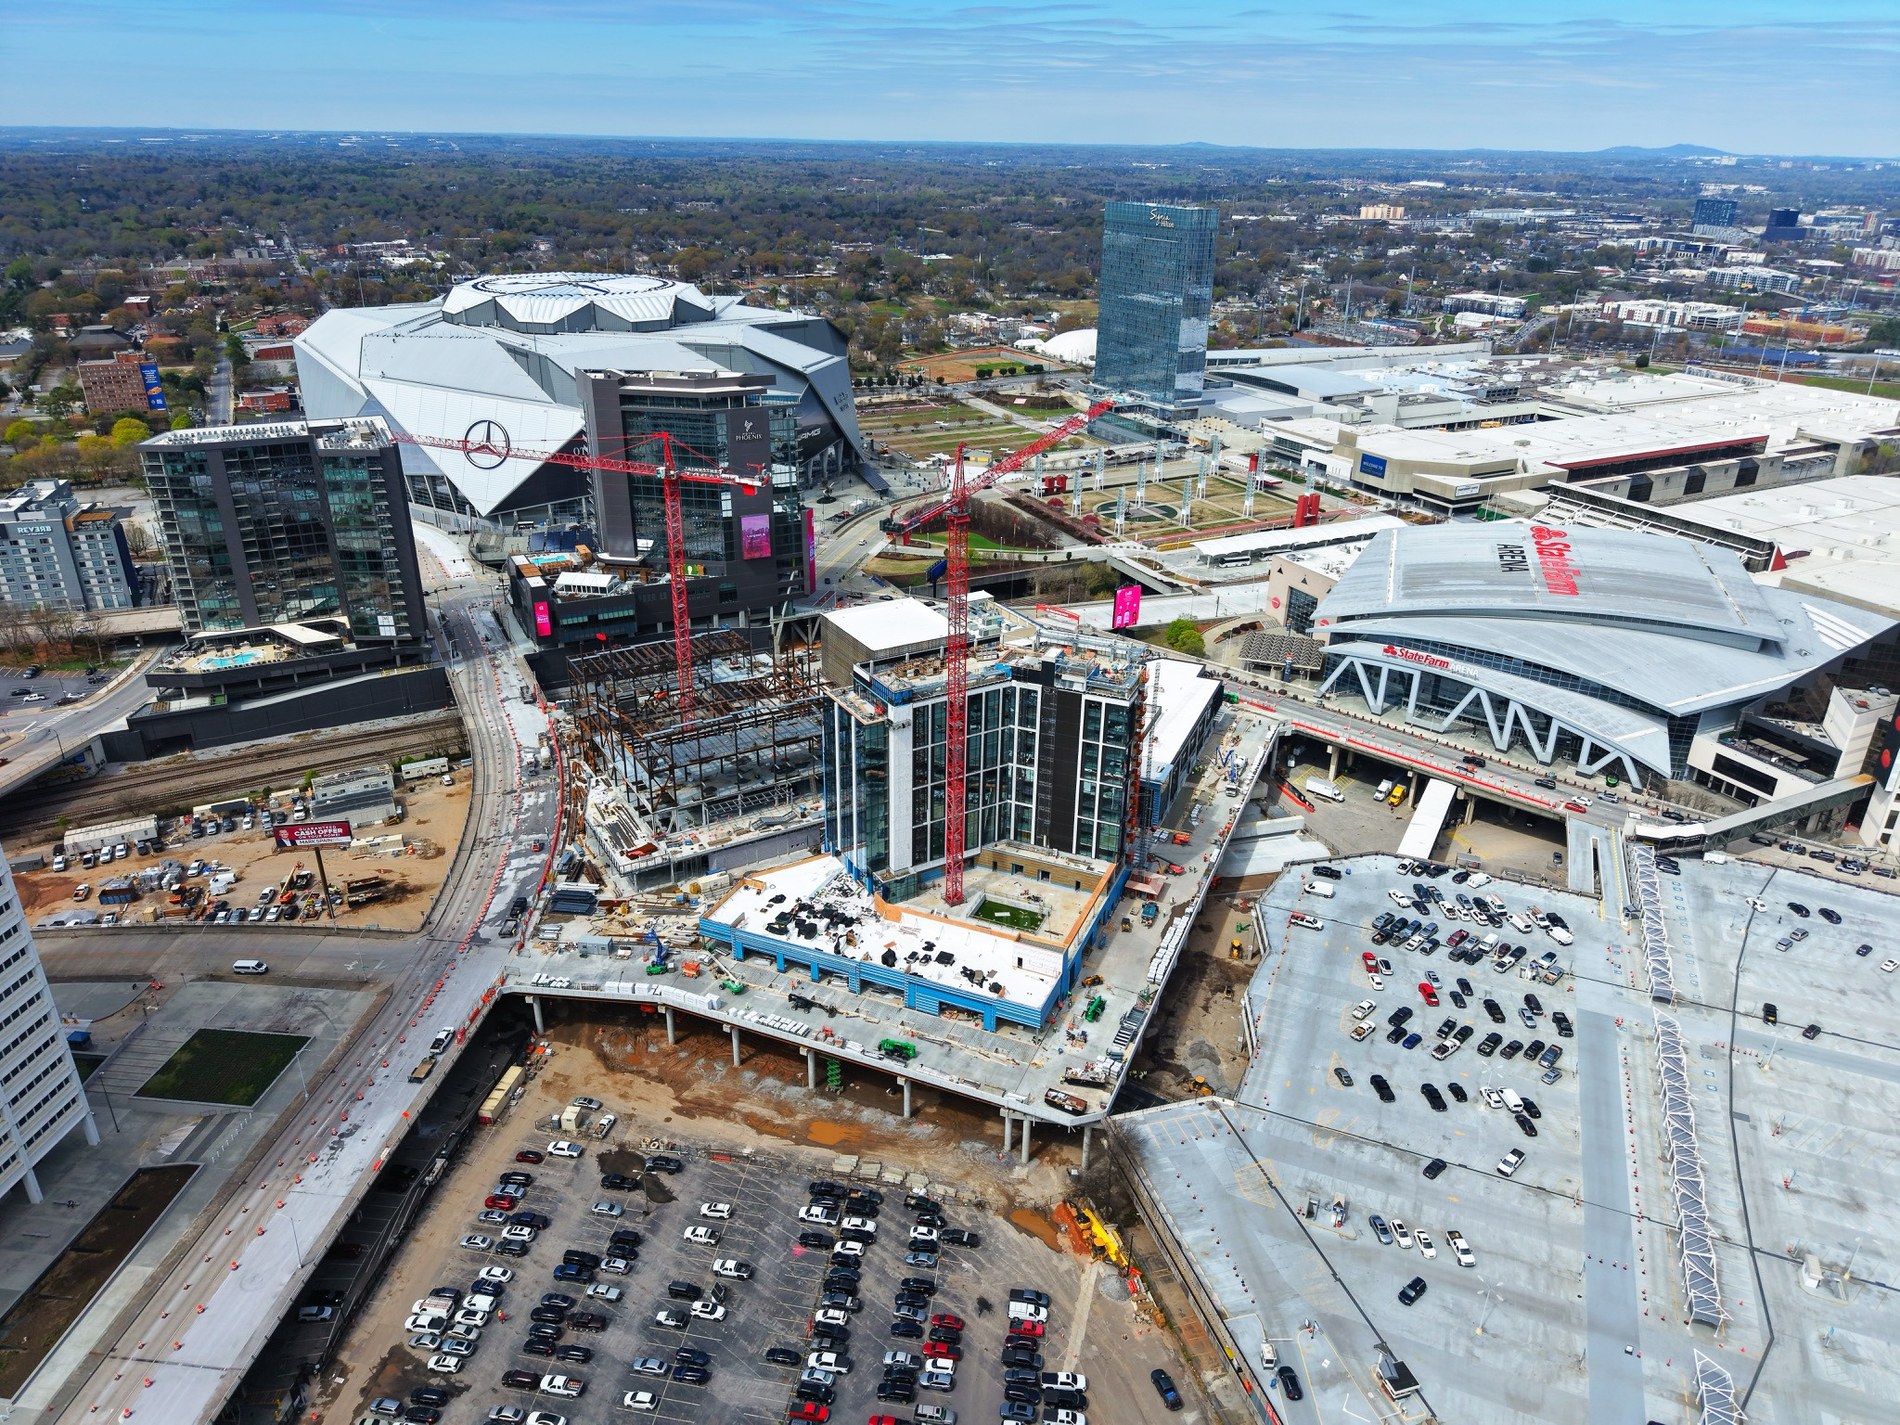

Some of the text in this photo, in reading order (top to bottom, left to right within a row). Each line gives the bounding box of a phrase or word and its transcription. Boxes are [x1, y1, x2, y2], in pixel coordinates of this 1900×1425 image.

[736, 433, 762, 441] PHOENIX
[800, 428, 821, 440] AMG
[1497, 543, 1529, 572] ARENA
[1534, 541, 1581, 596] State Farm
[1398, 648, 1479, 676] State Farm ARENA
